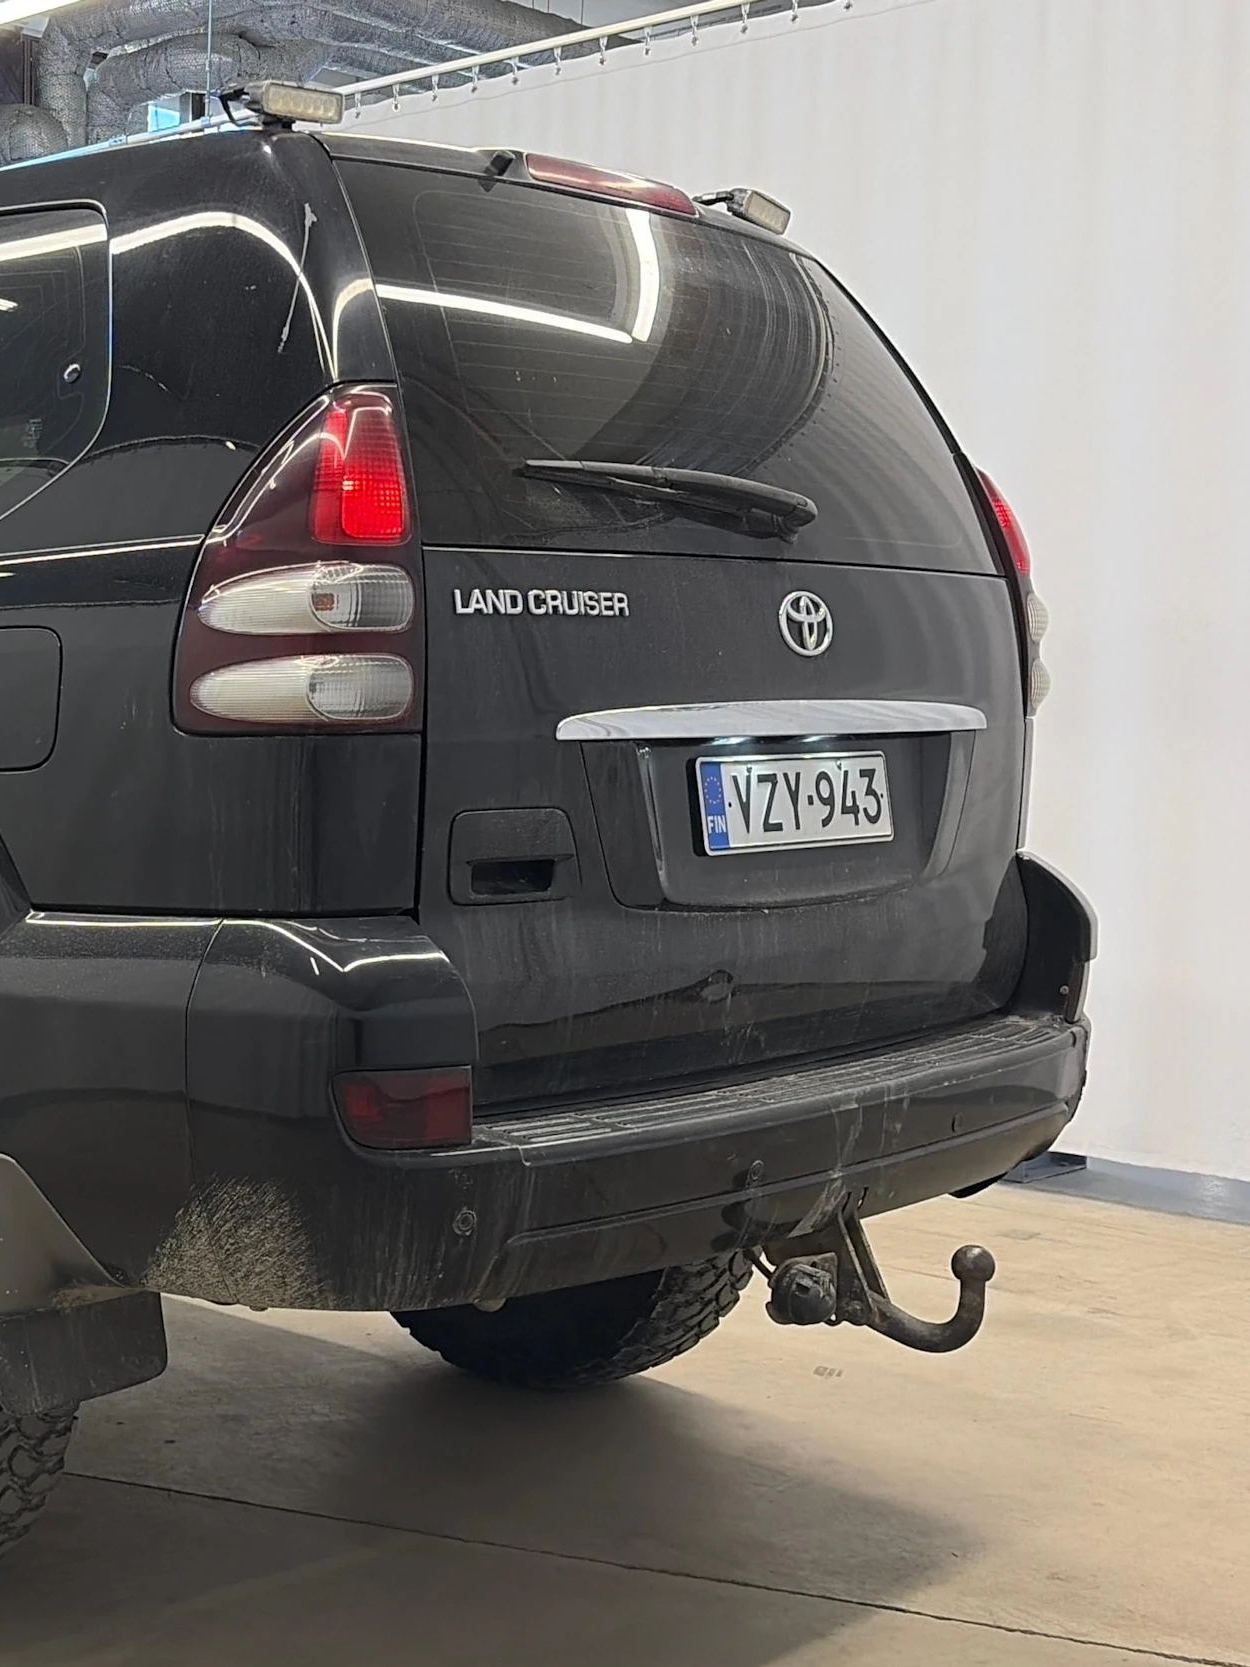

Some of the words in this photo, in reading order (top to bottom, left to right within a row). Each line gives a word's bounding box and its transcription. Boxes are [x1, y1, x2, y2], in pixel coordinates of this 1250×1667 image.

[453, 588, 524, 615] LAND
[527, 588, 630, 617] CRUISER
[731, 767, 882, 834] VZY-943
[707, 814, 727, 834] FIN
